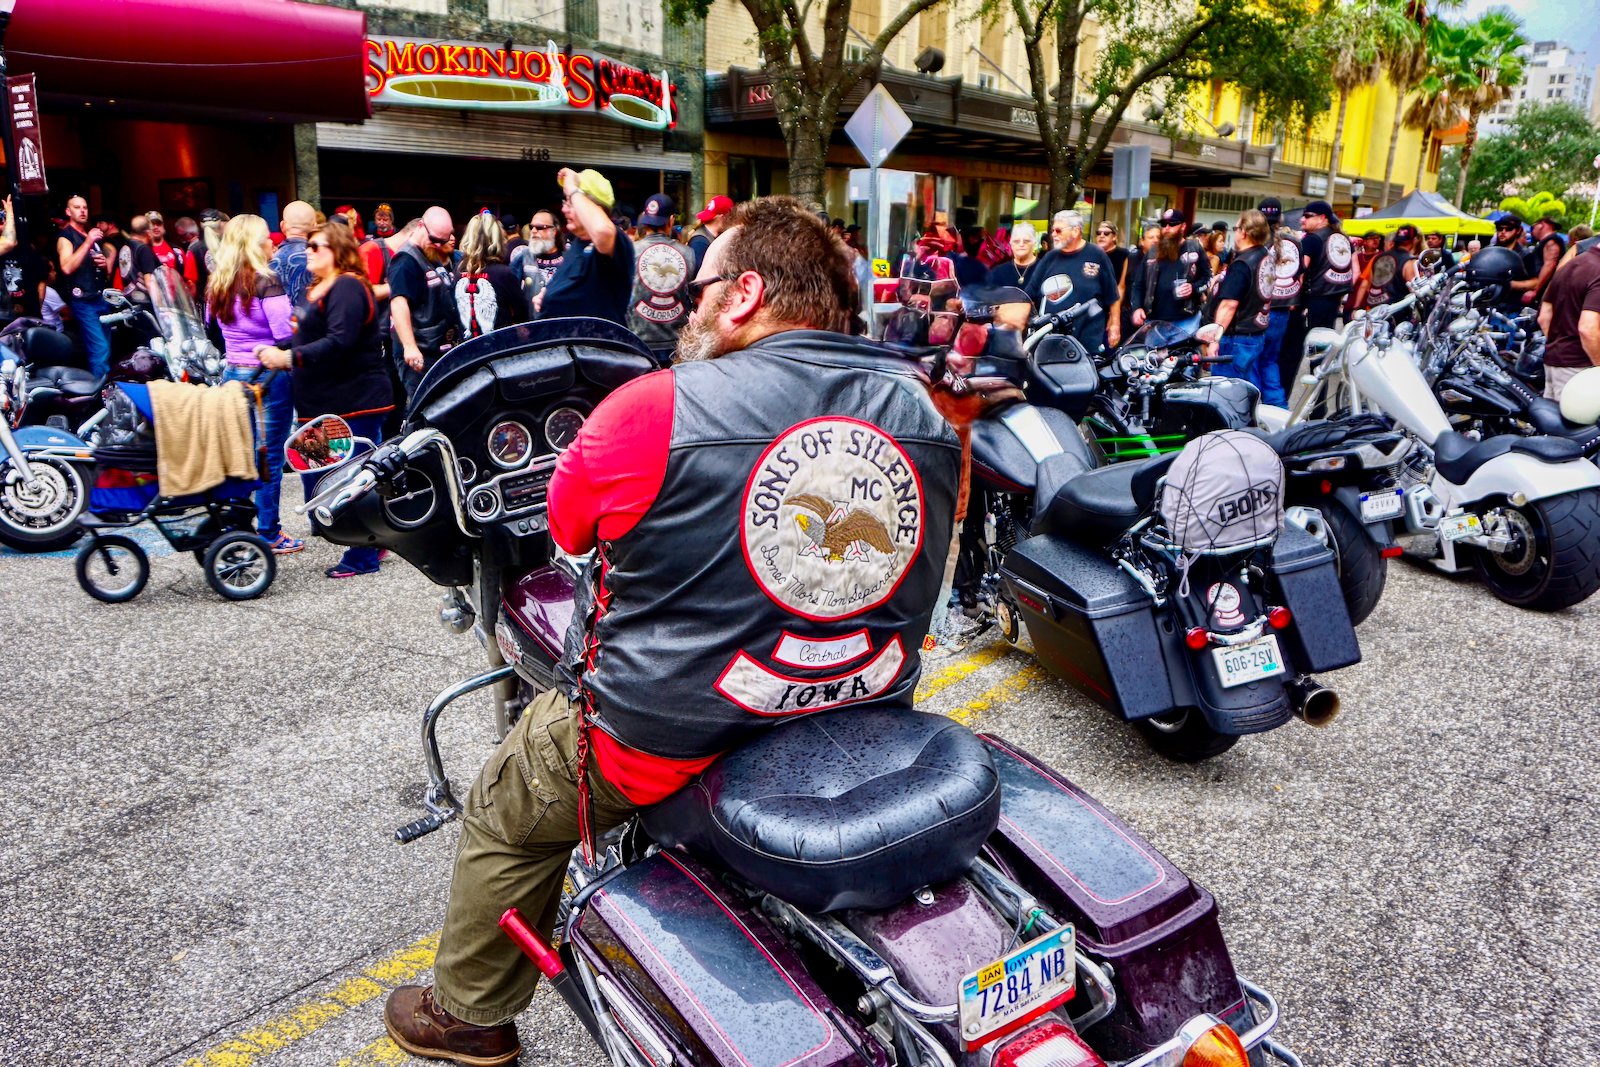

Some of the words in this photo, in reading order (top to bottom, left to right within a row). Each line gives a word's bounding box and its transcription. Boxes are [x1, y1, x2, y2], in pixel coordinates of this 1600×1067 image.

[520, 148, 550, 161] 1448
[642, 306, 680, 320] COLORADO
[752, 446, 800, 530] SONS
[801, 427, 834, 459] OF
[846, 428, 919, 545] SILENCE
[851, 476, 883, 501] MC
[760, 545, 787, 585] Donec
[821, 588, 847, 608] Non
[799, 644, 848, 663] Central
[775, 674, 870, 710] IOWA
[976, 967, 1033, 1018] 7284
[1040, 948, 1066, 986] NB
[981, 968, 1001, 983] JAN
[1003, 993, 1042, 1017] MARSHALL
